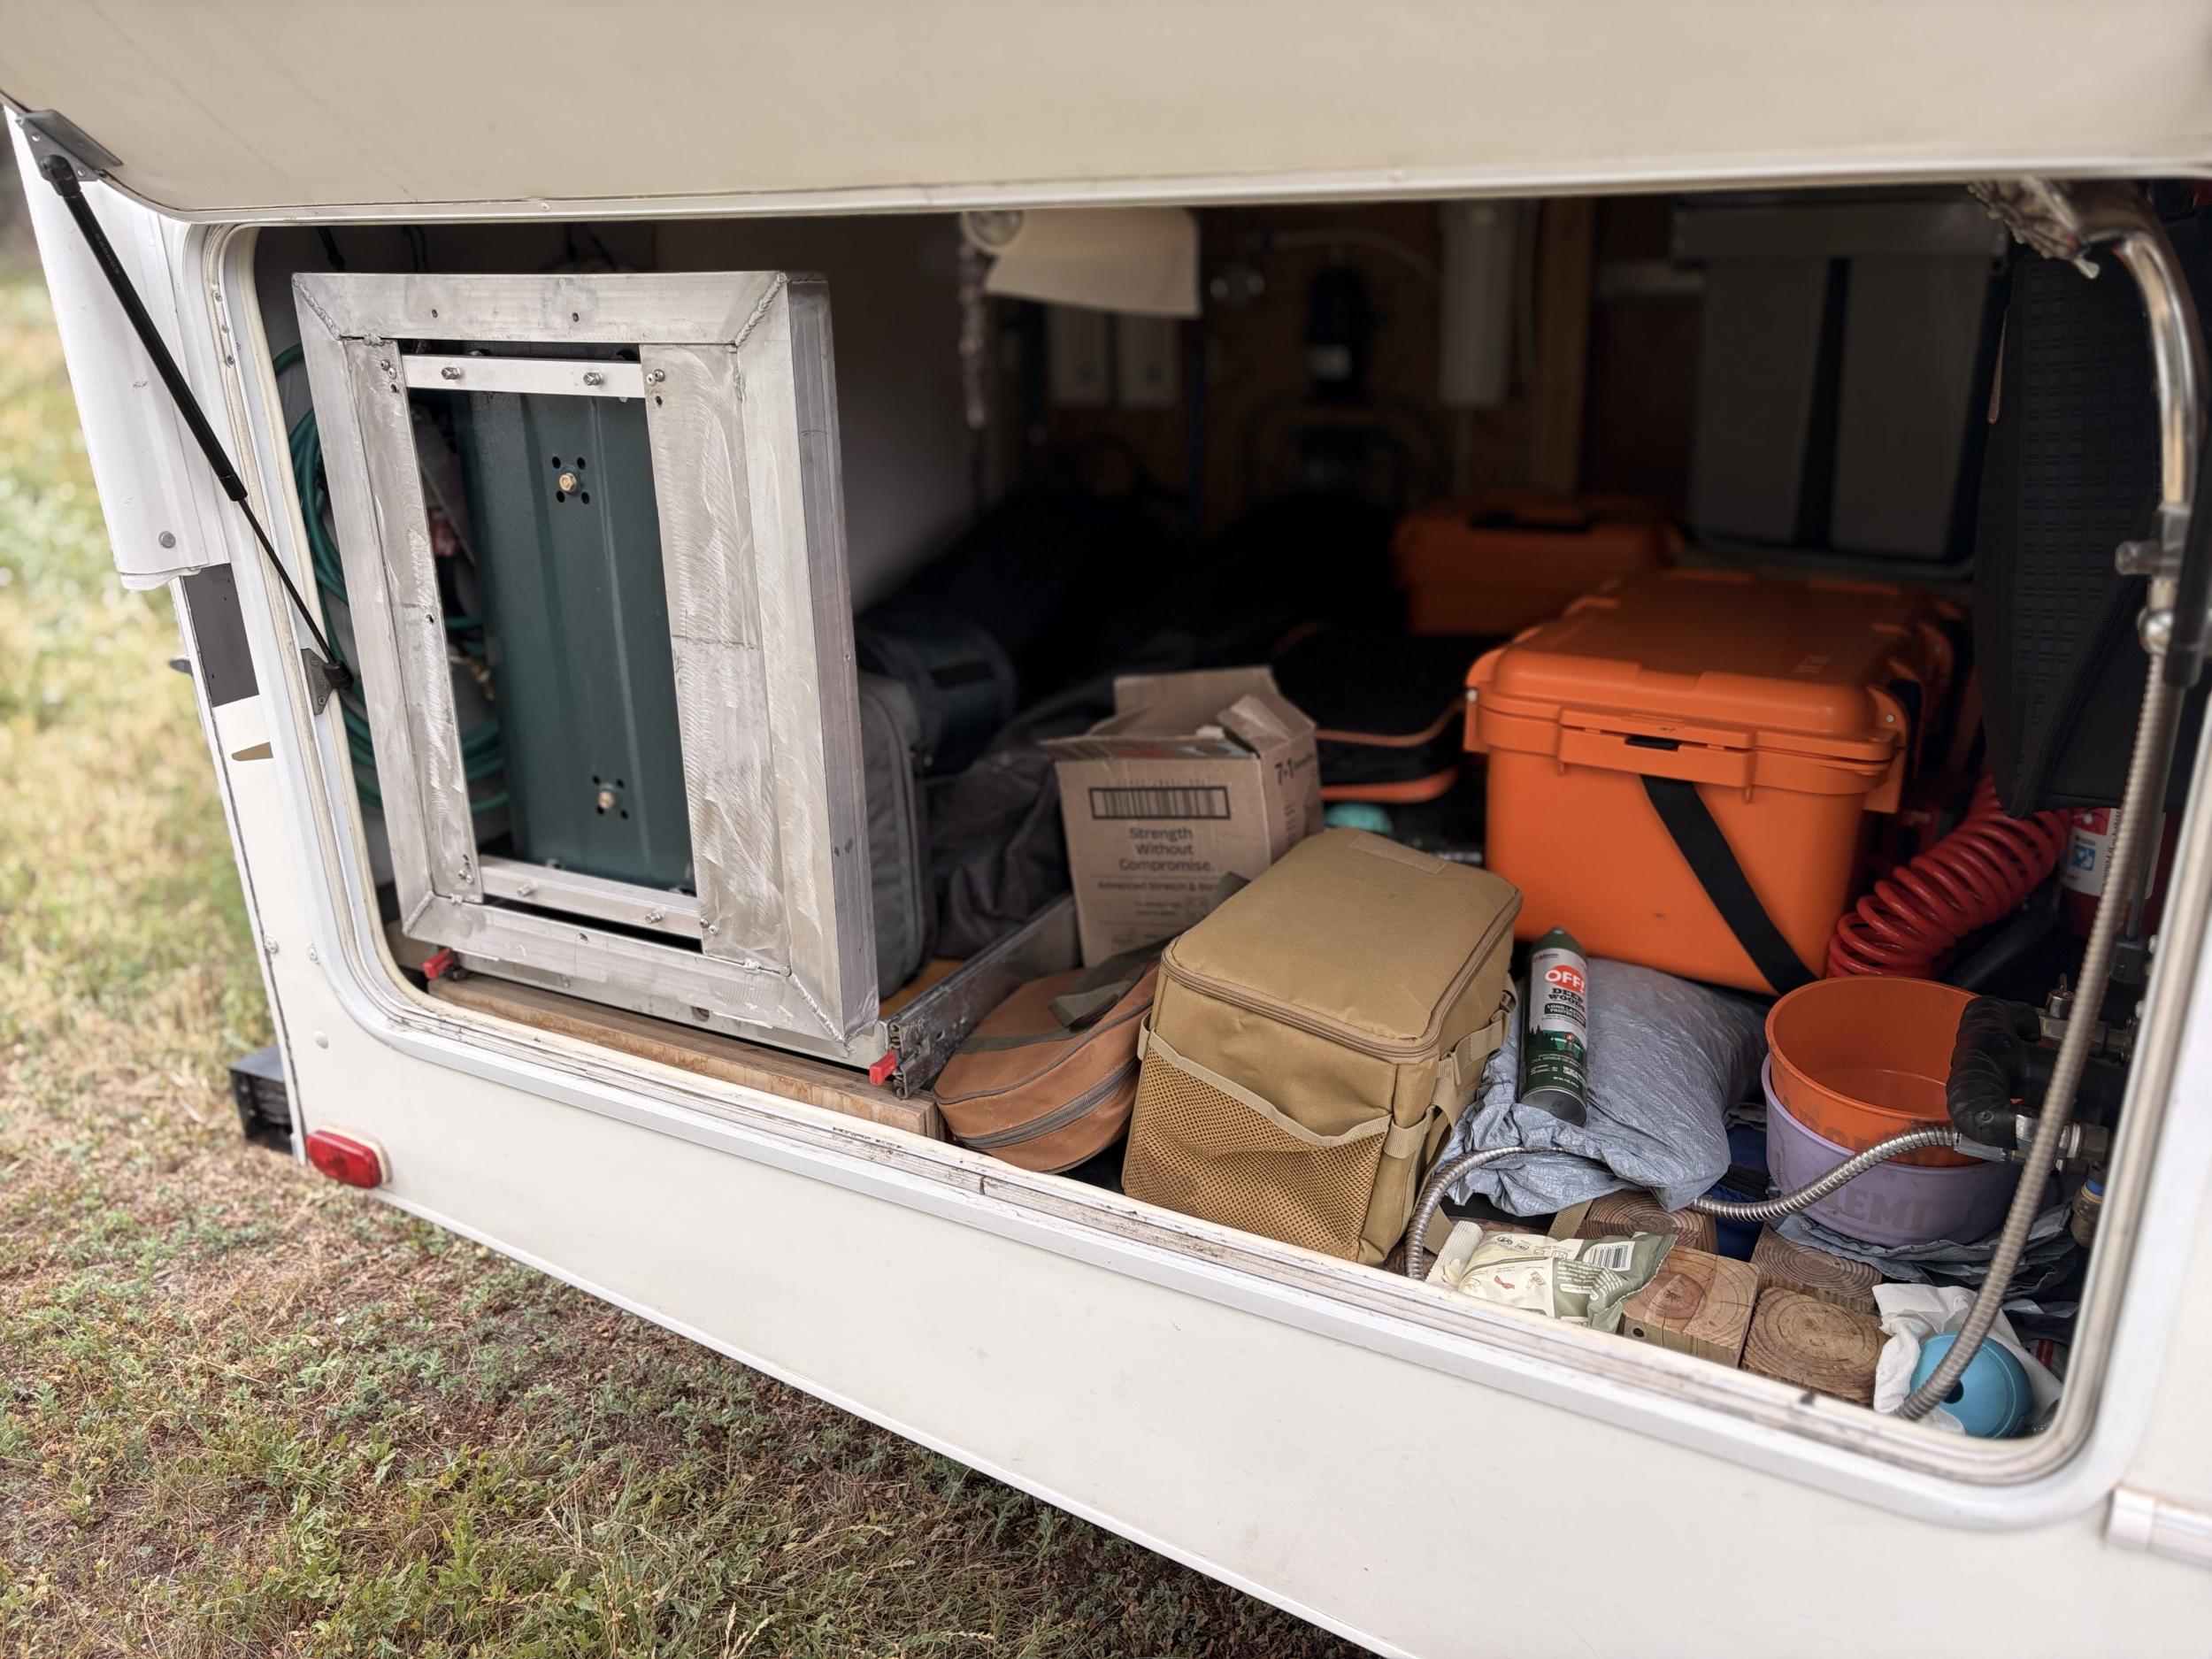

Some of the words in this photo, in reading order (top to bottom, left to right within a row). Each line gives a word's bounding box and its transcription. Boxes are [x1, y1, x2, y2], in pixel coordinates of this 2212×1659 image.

[1129, 827, 1194, 841] Strength
[1135, 843, 1194, 856] Without
[1118, 858, 1215, 872] Compromise.
[1545, 969, 1586, 994] OFF!
